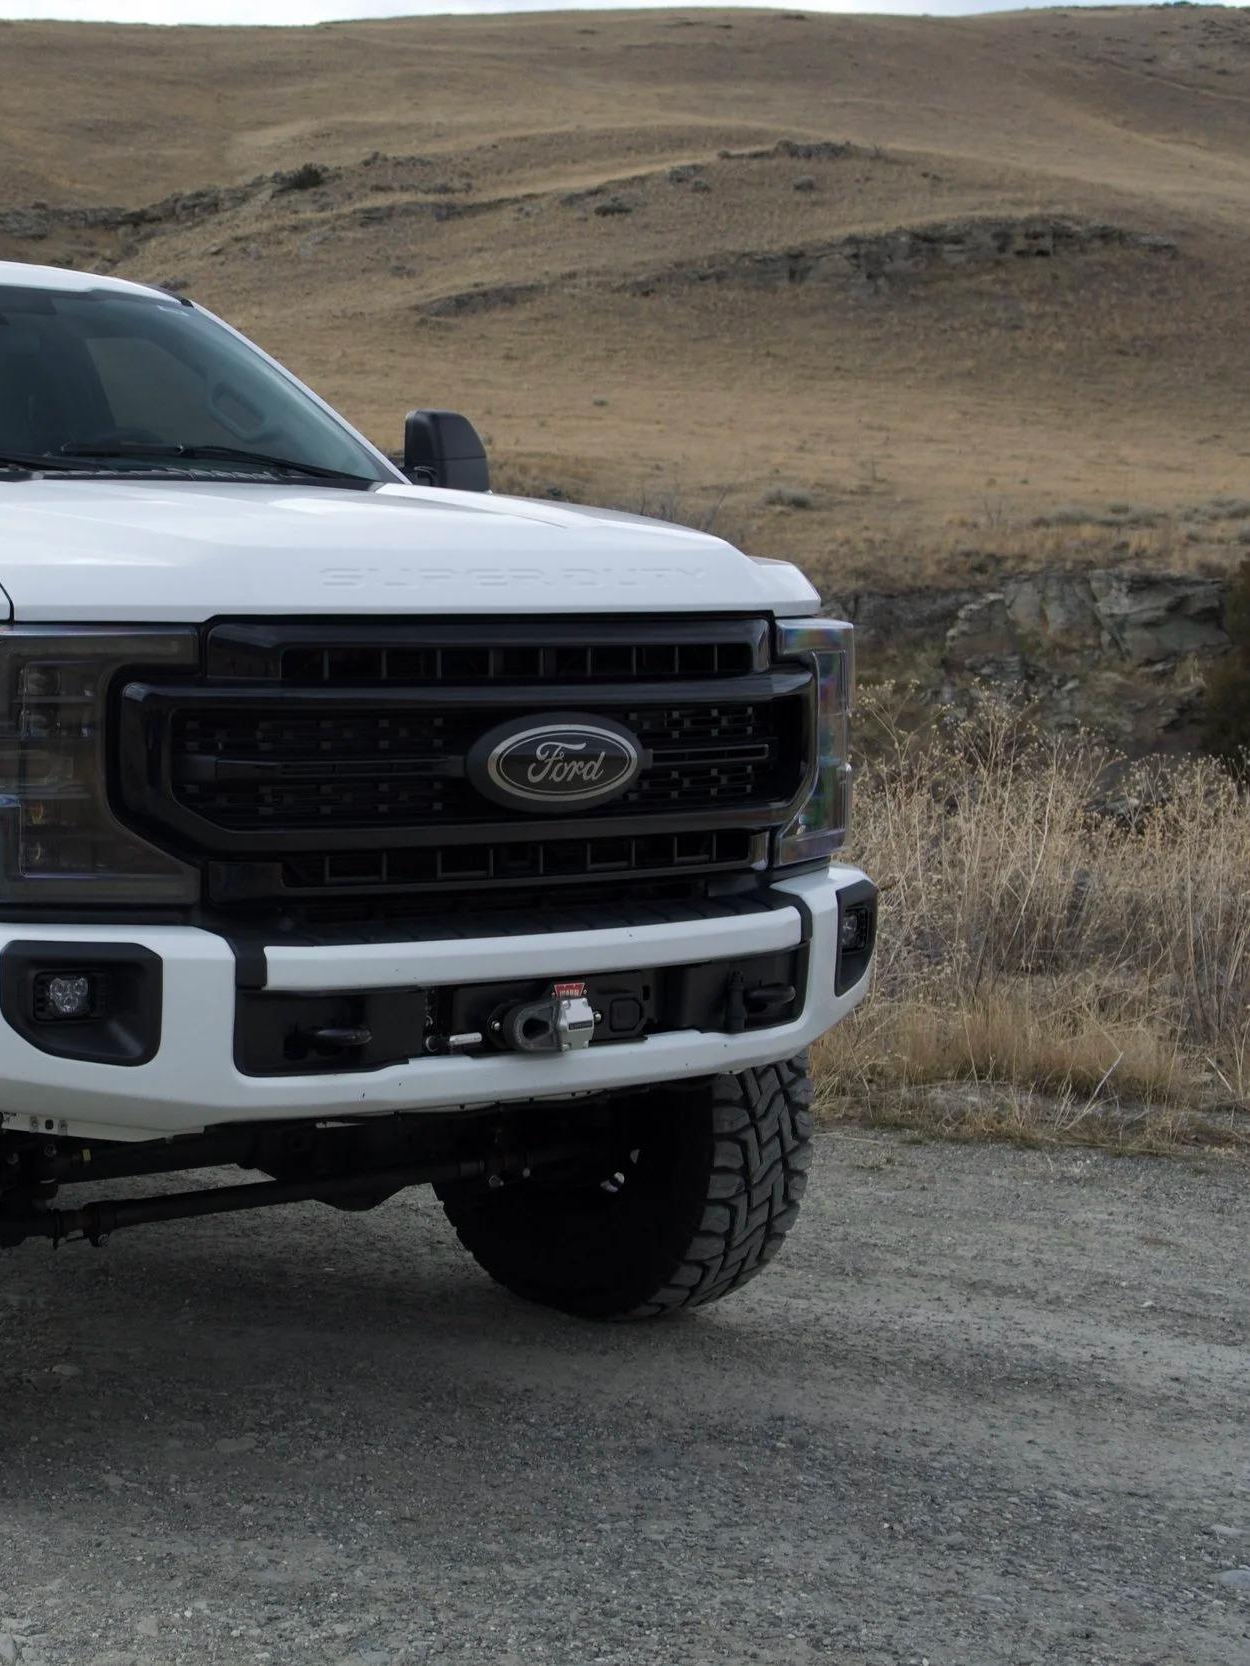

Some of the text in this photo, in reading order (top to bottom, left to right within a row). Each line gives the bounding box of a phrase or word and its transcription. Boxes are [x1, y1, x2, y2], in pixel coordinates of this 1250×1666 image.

[319, 567, 707, 588] SUPER DUTY
[527, 741, 607, 783] Ford
